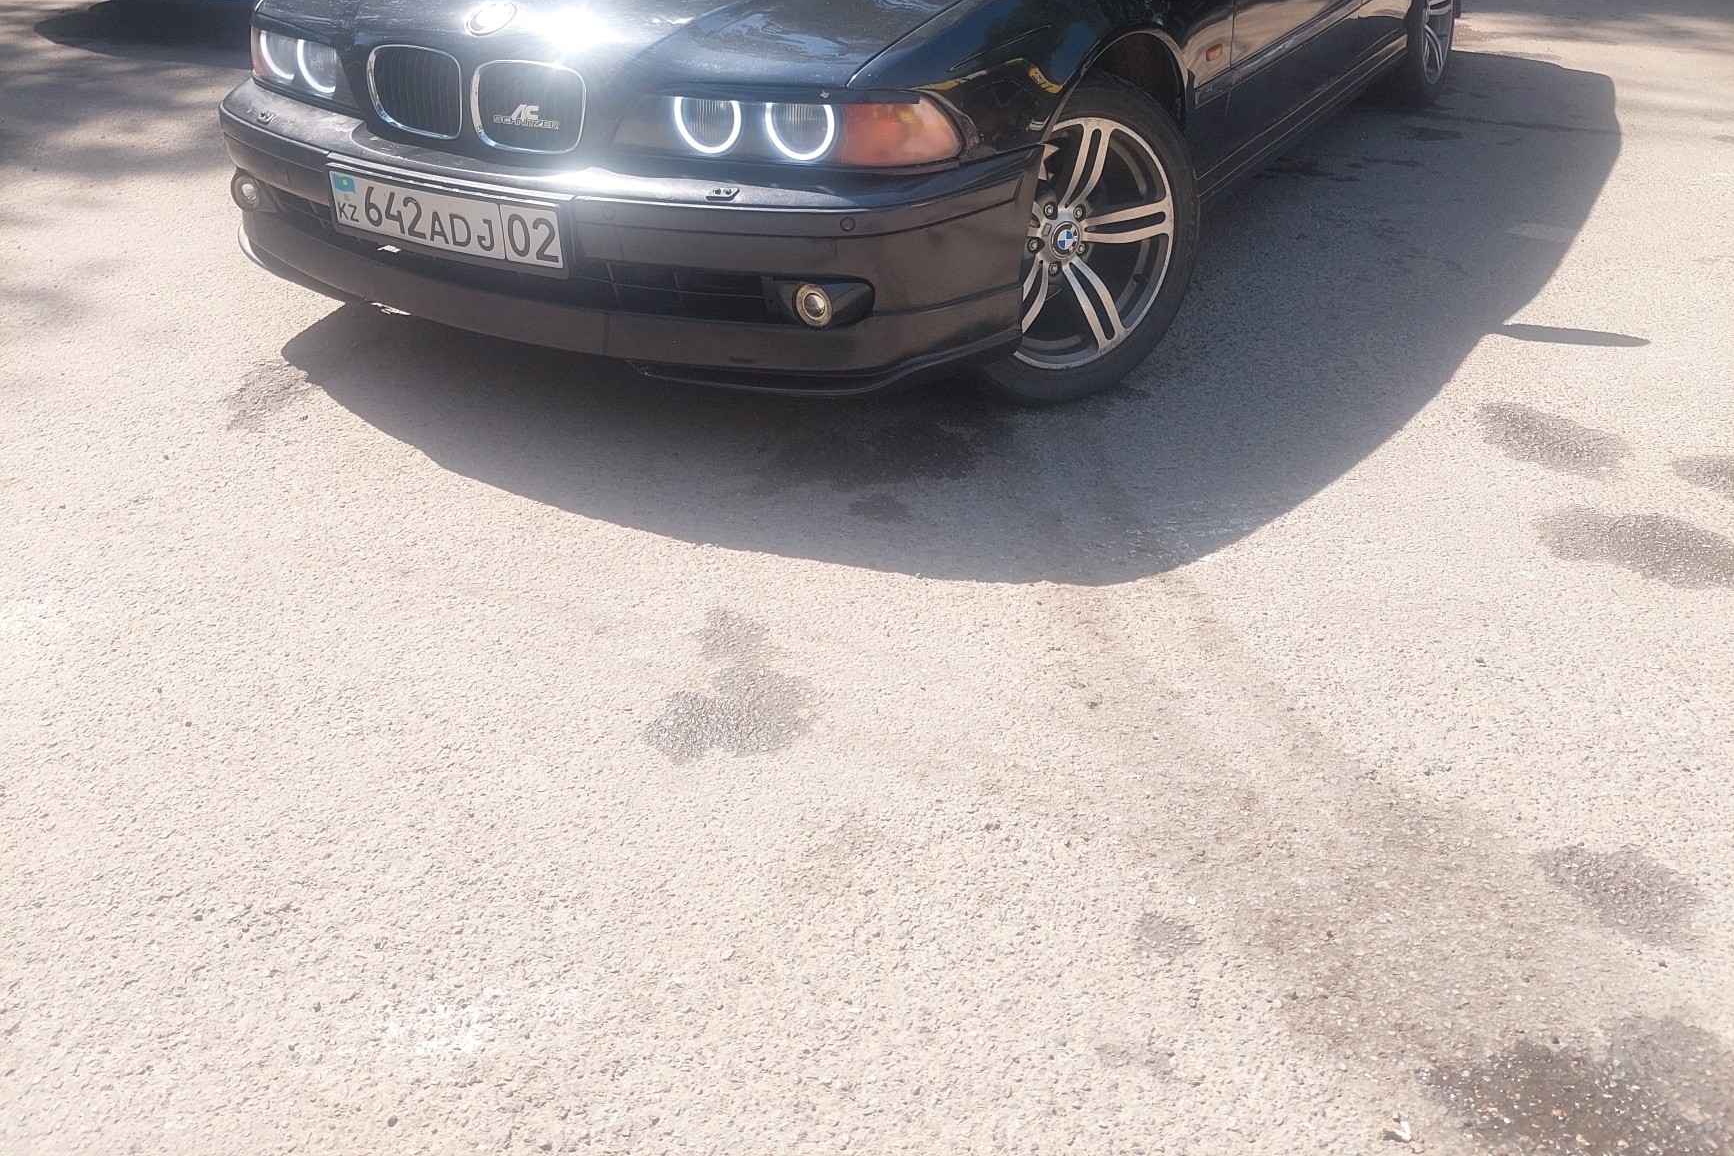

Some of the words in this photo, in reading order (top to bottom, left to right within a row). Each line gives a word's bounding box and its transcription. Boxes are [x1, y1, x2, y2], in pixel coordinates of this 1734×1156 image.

[493, 114, 559, 130] SCHNITZER
[337, 200, 359, 223] KZ
[507, 213, 559, 263] 02
